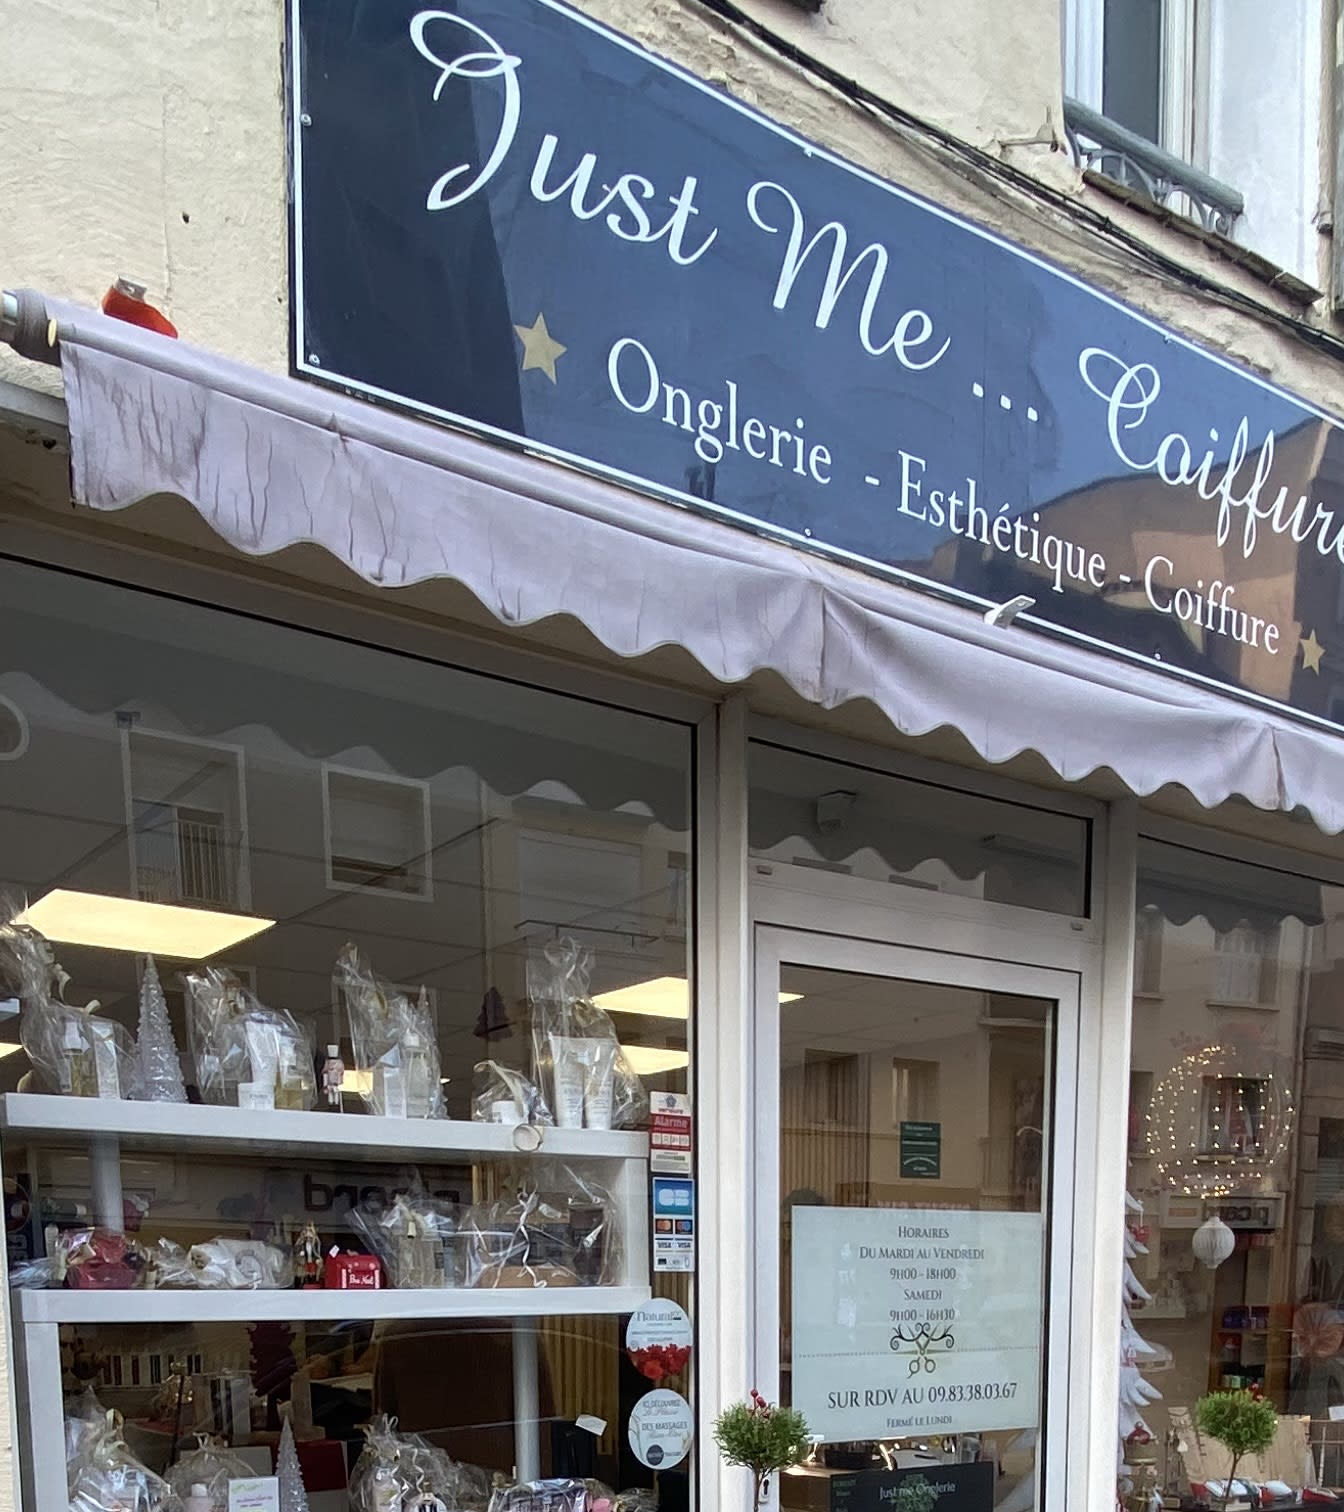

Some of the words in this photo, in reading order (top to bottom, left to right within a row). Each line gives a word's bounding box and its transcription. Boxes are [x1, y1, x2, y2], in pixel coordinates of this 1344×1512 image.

[409, 9, 722, 267] Just
[746, 181, 950, 372] Me
[606, 337, 833, 487] Onglerie
[897, 450, 1106, 600] Esthétique
[1143, 553, 1280, 656] Coiffure
[828, 1391, 861, 1409] SUR
[864, 1388, 898, 1407] RDV
[902, 1387, 924, 1405] AU
[880, 1486, 897, 1500] Just
[916, 1481, 956, 1501] Onglerie
